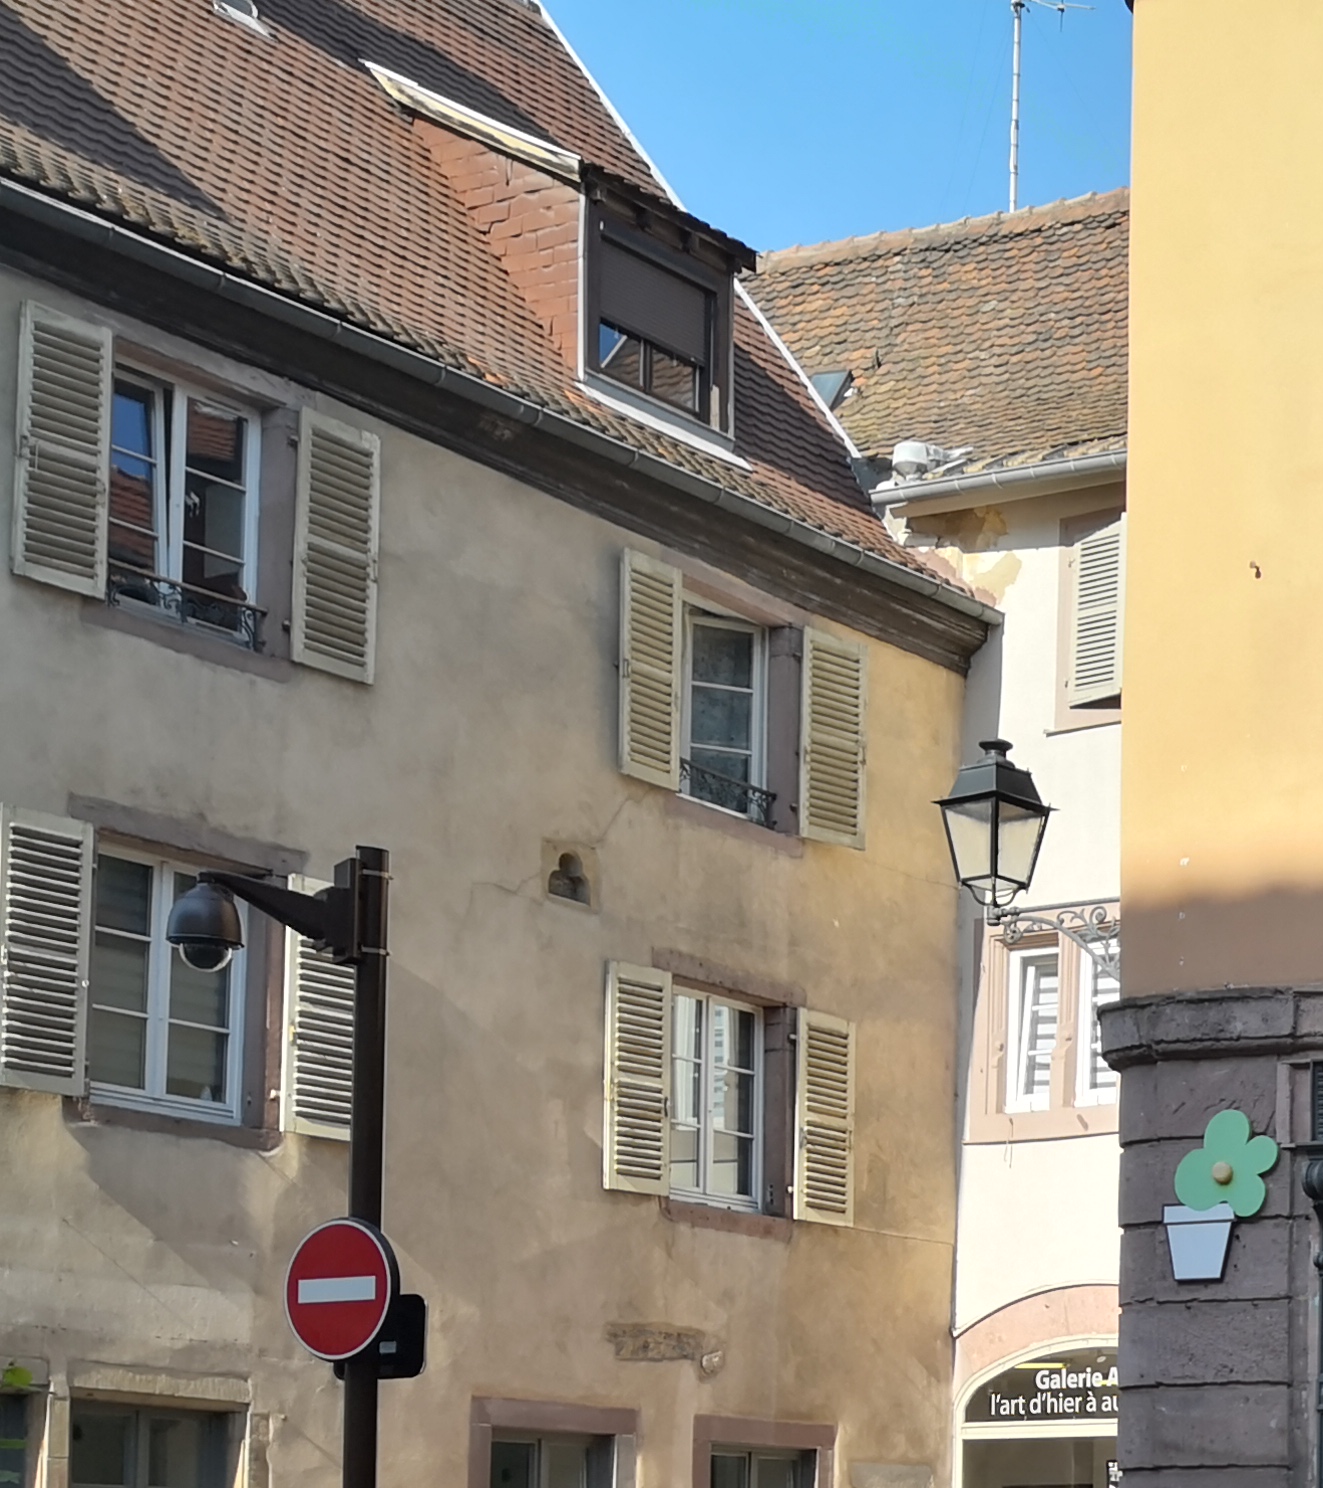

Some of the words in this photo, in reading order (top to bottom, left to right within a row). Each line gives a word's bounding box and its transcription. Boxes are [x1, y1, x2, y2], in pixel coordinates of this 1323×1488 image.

[1035, 1366, 1102, 1390] Galerie
[990, 1392, 1027, 1416] l'art
[1029, 1390, 1083, 1415] d'hier
[1086, 1389, 1098, 1413] à
